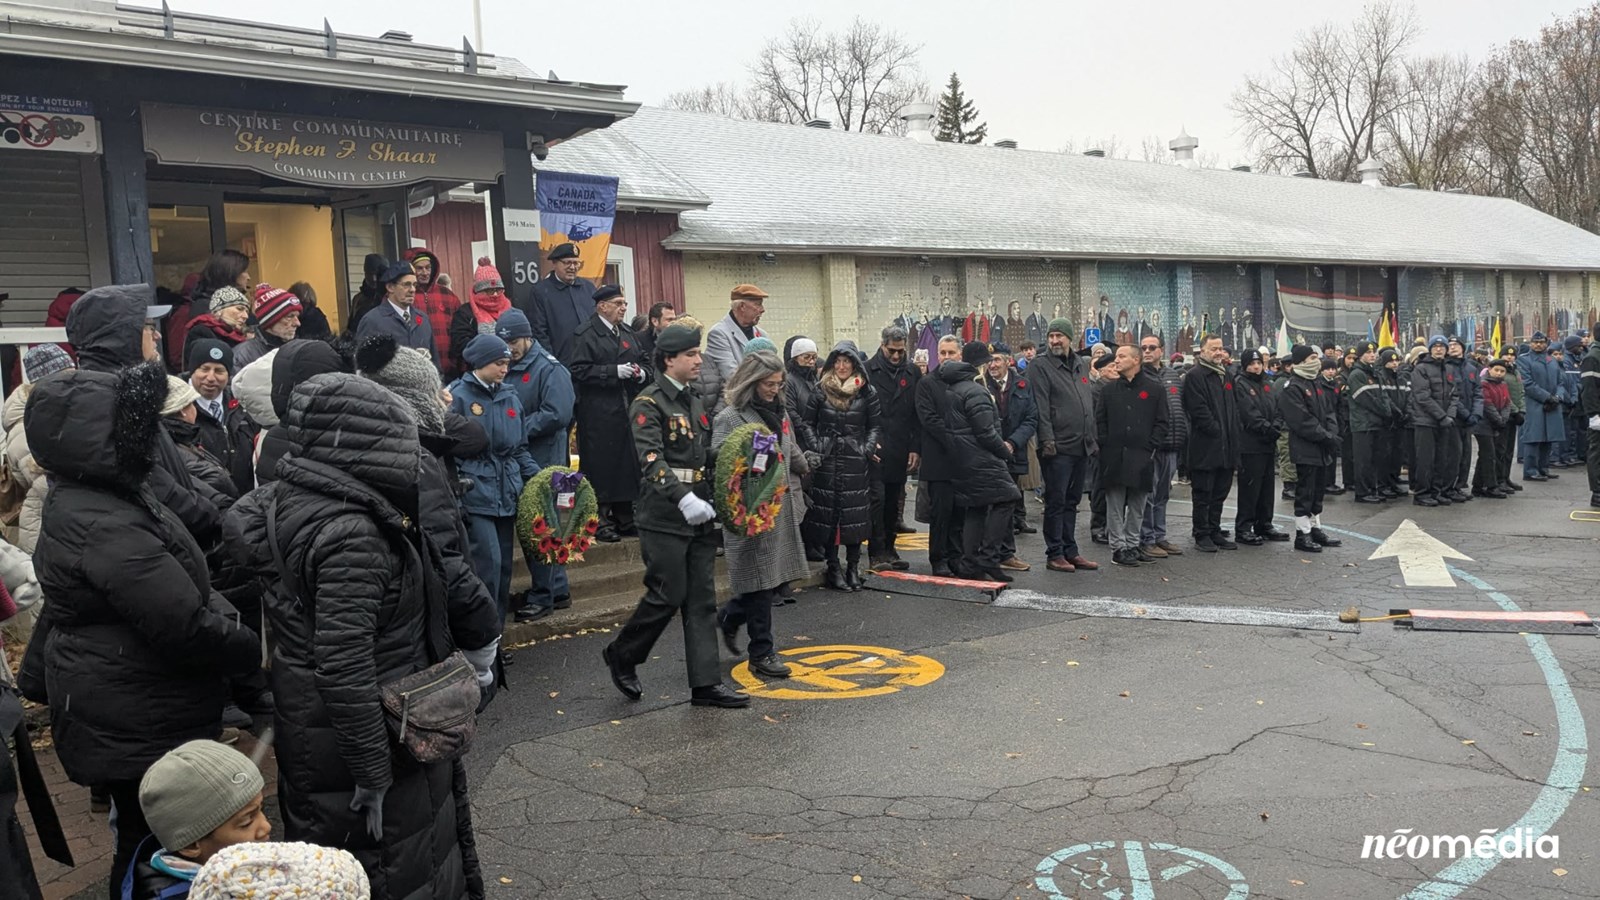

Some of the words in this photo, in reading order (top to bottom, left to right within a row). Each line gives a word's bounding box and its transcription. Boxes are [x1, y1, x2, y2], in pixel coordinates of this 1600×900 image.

[26, 96, 38, 104] LE
[44, 98, 82, 108] MOTEUR
[200, 112, 282, 131] CENTRE
[293, 120, 462, 145] COMMUNAUTAIRE
[235, 132, 326, 159] Stephen
[368, 142, 437, 164] Shaar
[274, 162, 357, 181] COMMUNITY
[362, 170, 407, 182] CENTER
[558, 186, 596, 200] CANADA
[547, 198, 606, 213] REMEMBERS
[519, 221, 536, 229] Main
[514, 261, 539, 284] 56
